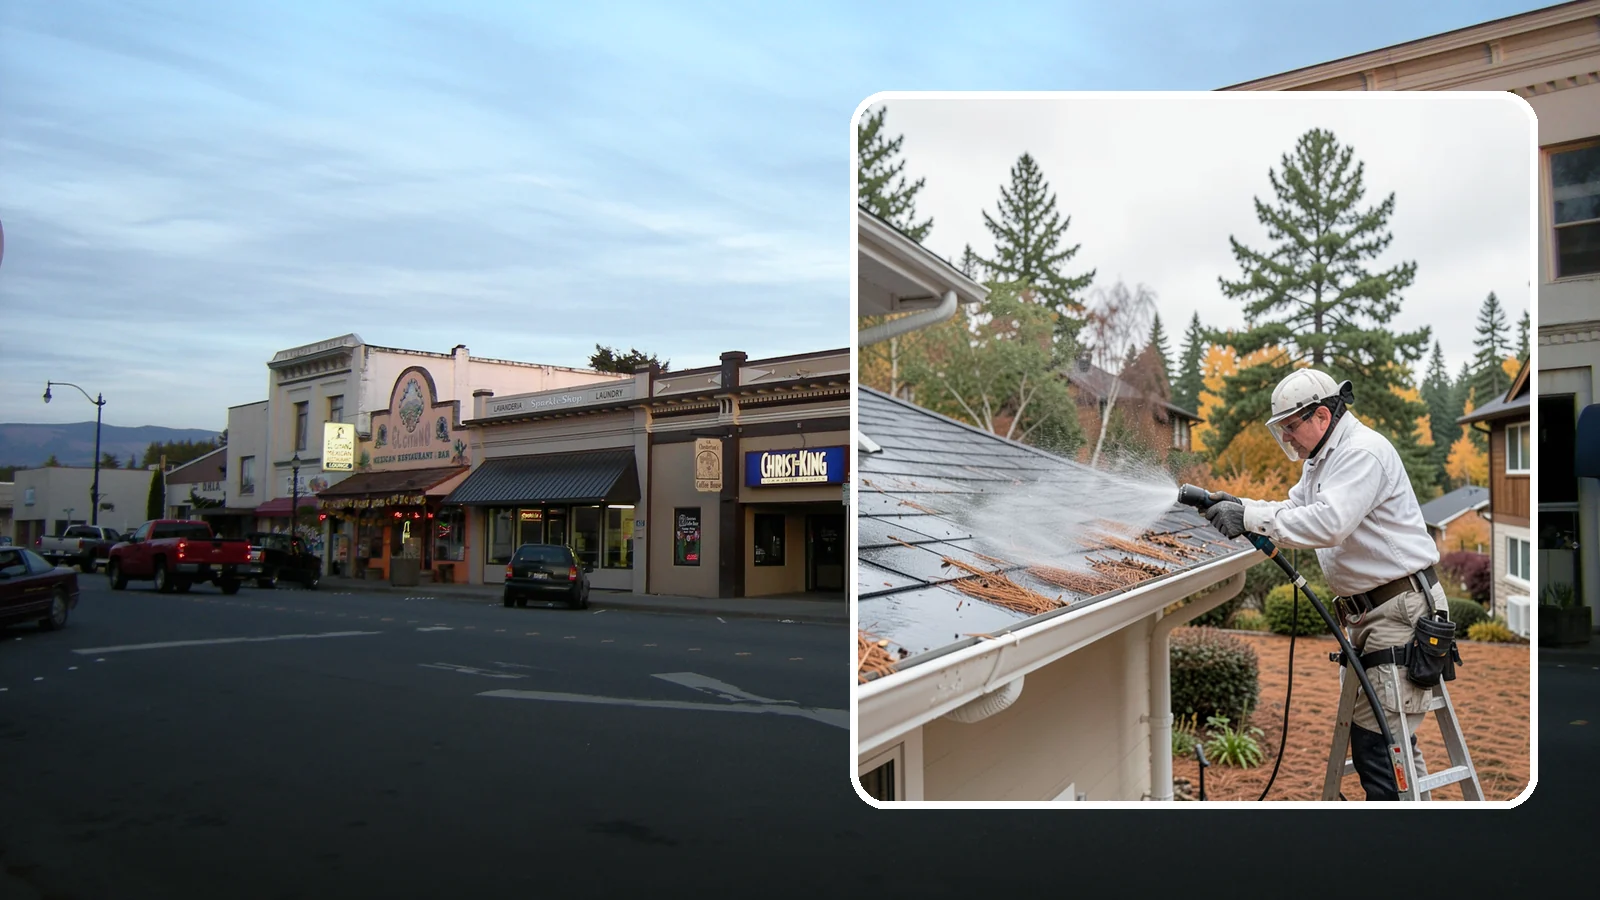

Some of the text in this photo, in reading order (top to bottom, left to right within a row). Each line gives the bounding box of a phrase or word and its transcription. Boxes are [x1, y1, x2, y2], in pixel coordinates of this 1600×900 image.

[562, 394, 583, 406] Shop
[595, 389, 623, 400] LAUNDRY
[493, 402, 522, 412] LAVANDERIA
[374, 455, 396, 464] MEXICAN
[397, 451, 434, 462] RESTAURANT
[438, 449, 450, 458] BAR
[761, 450, 827, 478] CHRIST KING
[696, 480, 709, 488] Coffee
